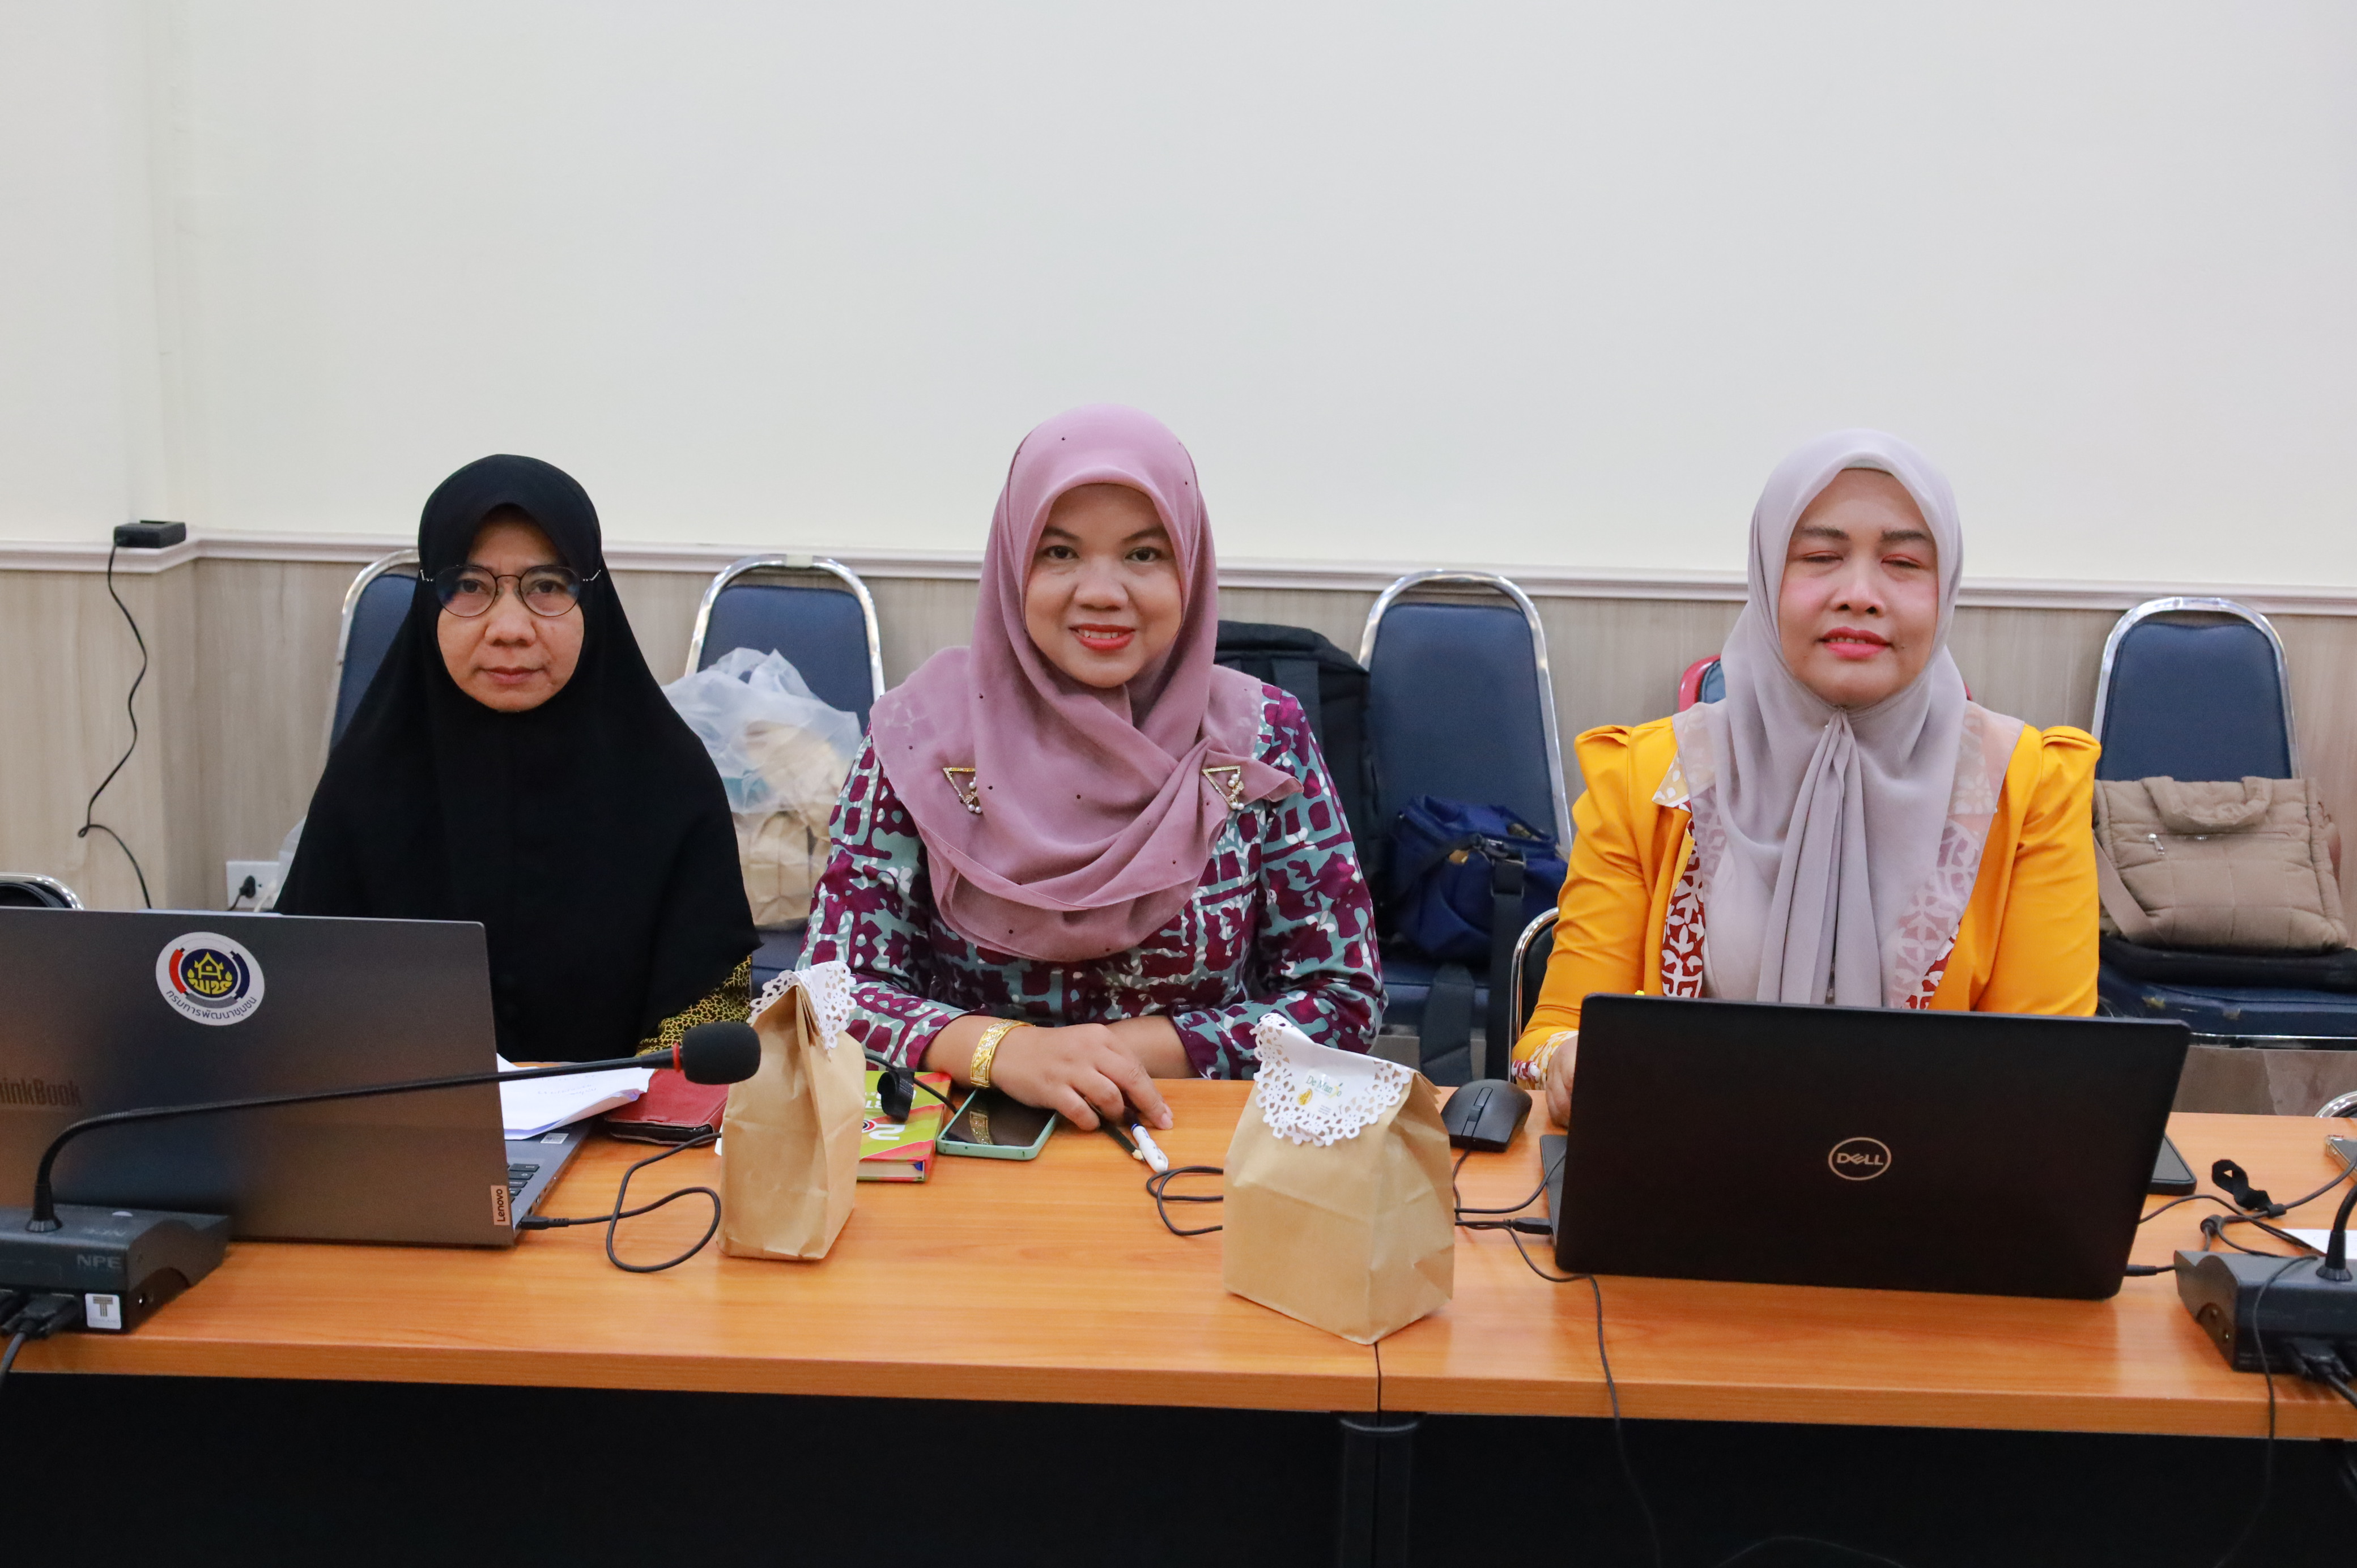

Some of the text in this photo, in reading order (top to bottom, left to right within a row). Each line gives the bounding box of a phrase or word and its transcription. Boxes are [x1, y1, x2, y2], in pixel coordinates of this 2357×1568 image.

[165, 990, 257, 1019] กรมการพัฒนาชุมชน
[0, 1077, 82, 1106] inkBook
[1836, 1152, 1884, 1165] DELL
[496, 1188, 506, 1222] Lenovo
[76, 1254, 122, 1269] NPE
